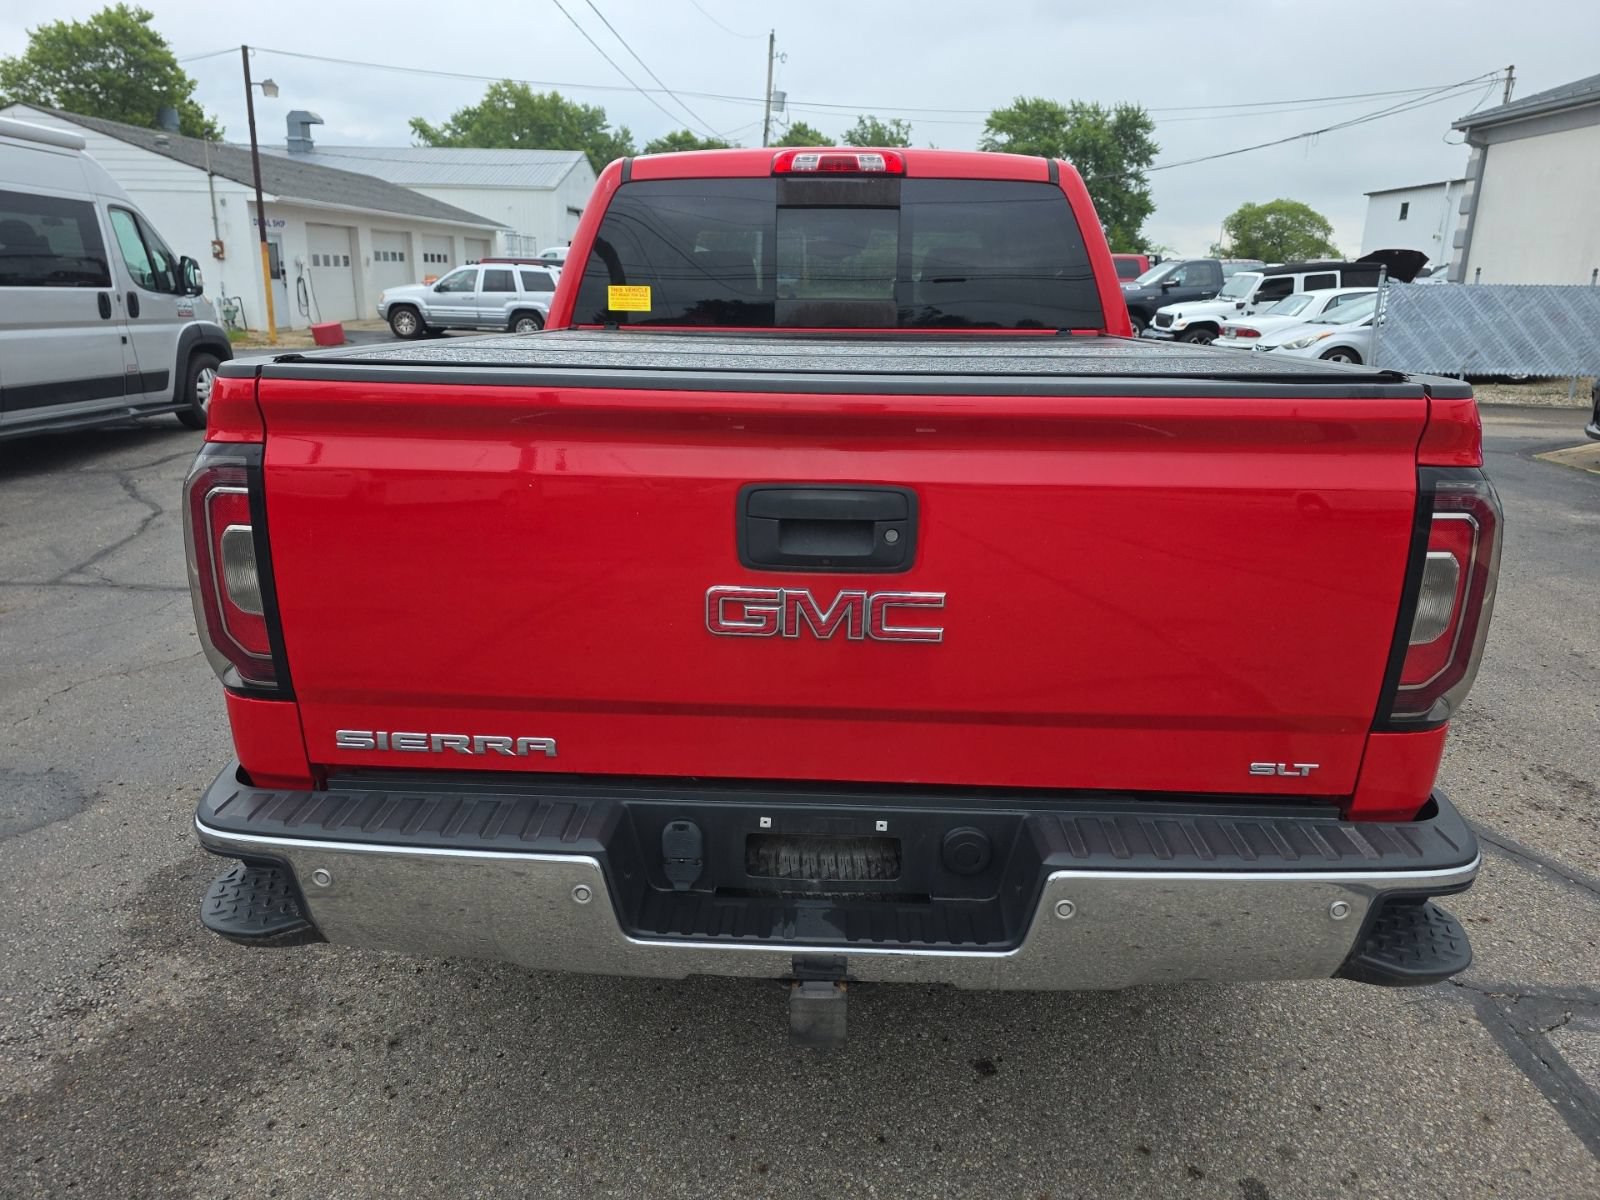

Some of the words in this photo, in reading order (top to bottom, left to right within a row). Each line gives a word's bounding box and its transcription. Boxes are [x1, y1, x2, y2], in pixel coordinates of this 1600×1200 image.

[705, 585, 946, 642] GMC
[336, 730, 557, 757] SIERRA
[1249, 762, 1319, 776] SLT
